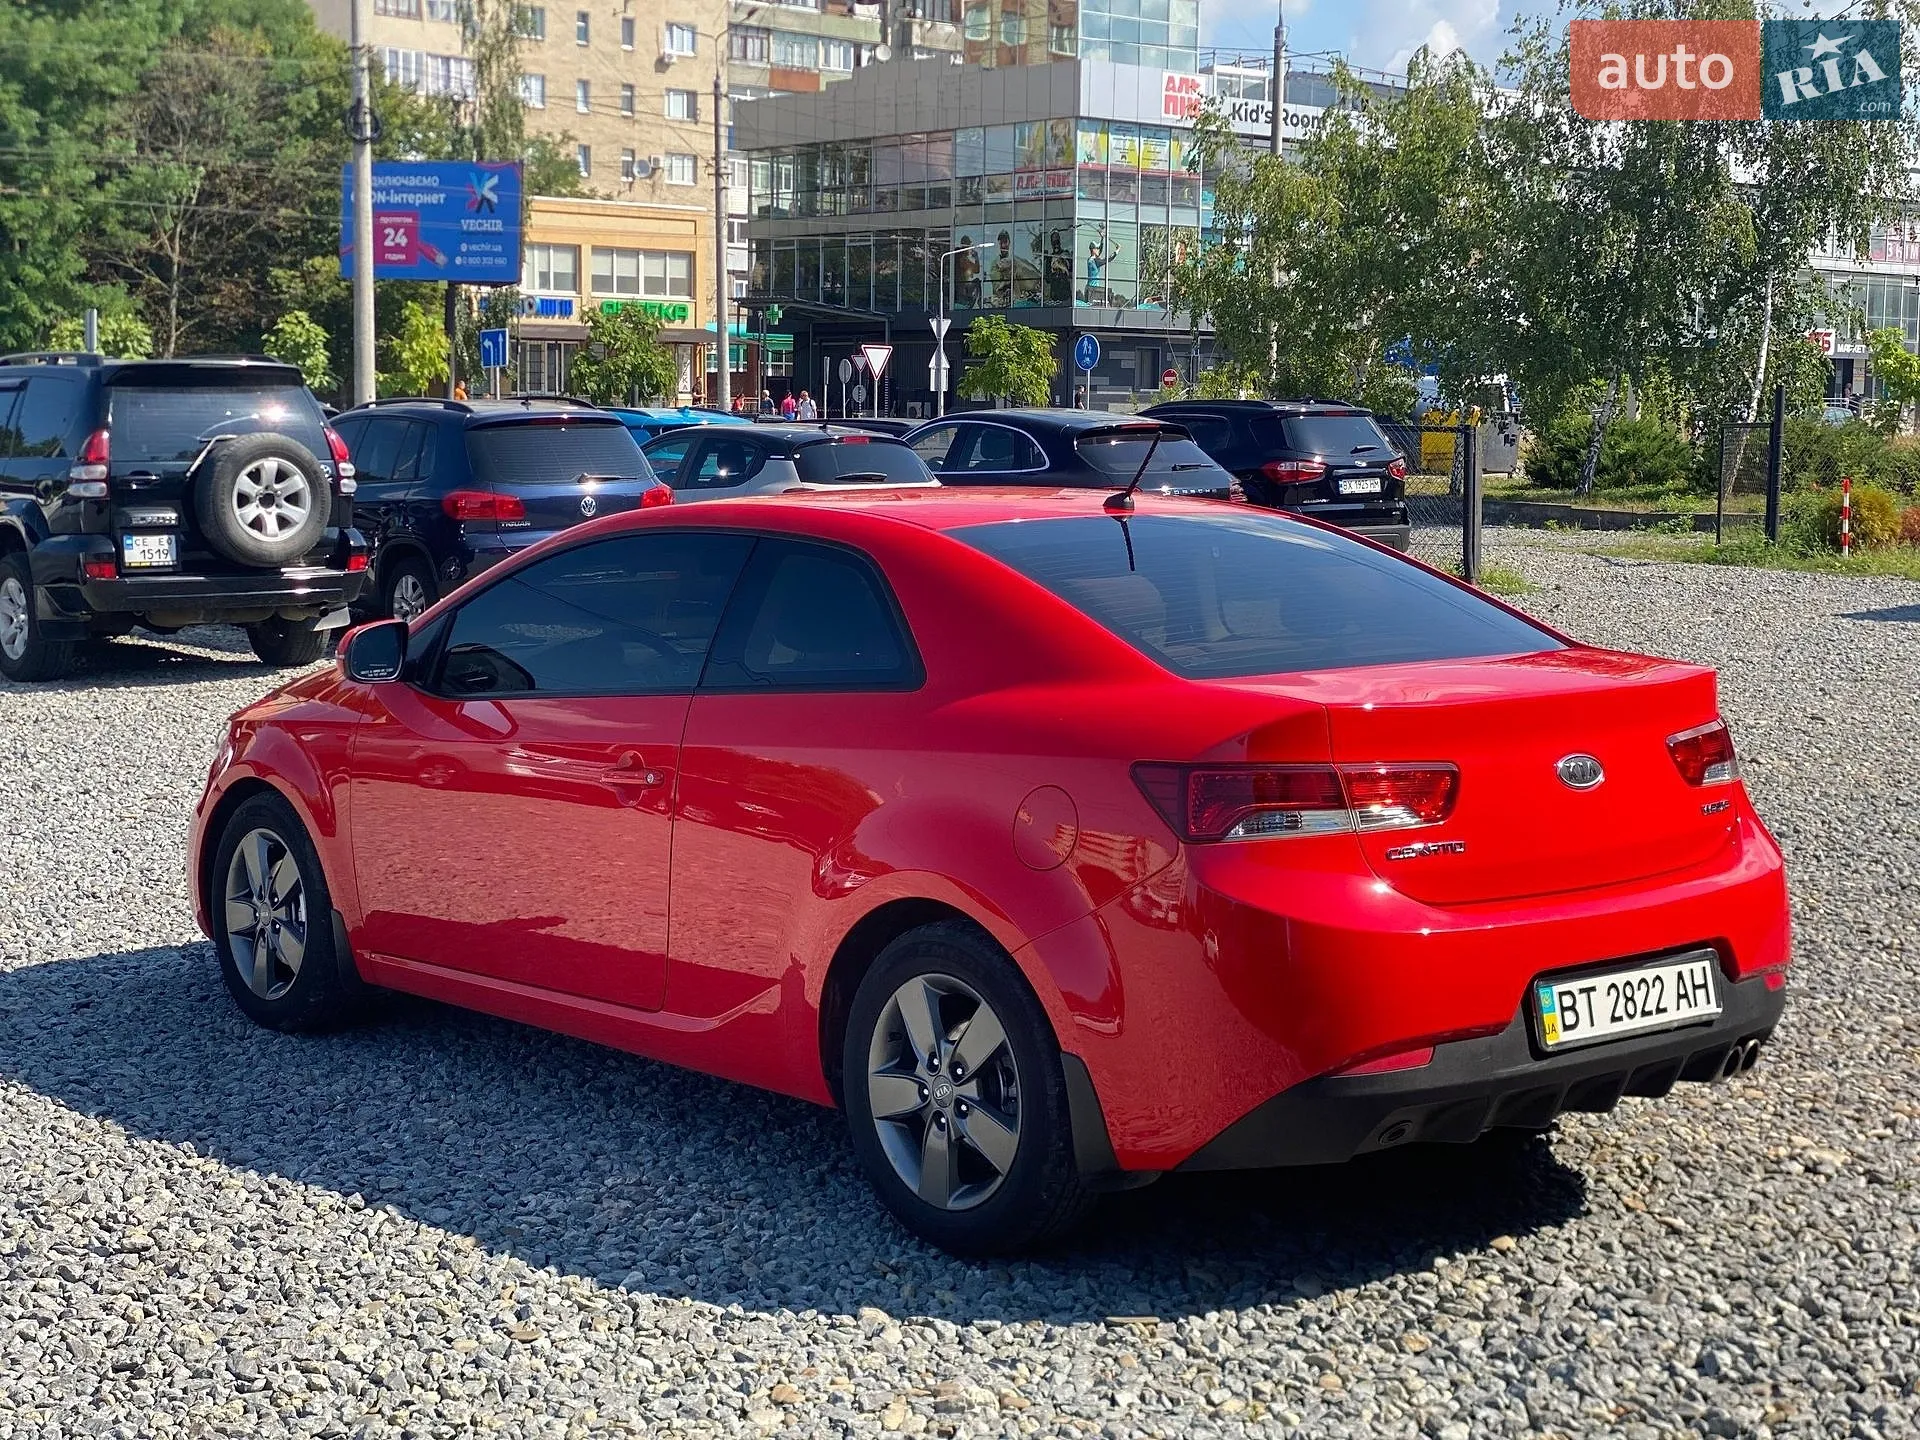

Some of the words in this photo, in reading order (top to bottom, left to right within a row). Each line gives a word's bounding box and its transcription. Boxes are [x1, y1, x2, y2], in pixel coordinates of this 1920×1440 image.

[1232, 102, 1273, 124] Kid's
[461, 219, 504, 232] VECHIR
[384, 227, 408, 247] 24
[134, 538, 148, 546] CE
[140, 548, 169, 560] 1519
[1386, 841, 1464, 859] CERATO
[1558, 985, 1597, 1032] BT
[1606, 974, 1668, 1024] 2822
[1676, 966, 1711, 1011] AH
[935, 1085, 950, 1098] KIA
